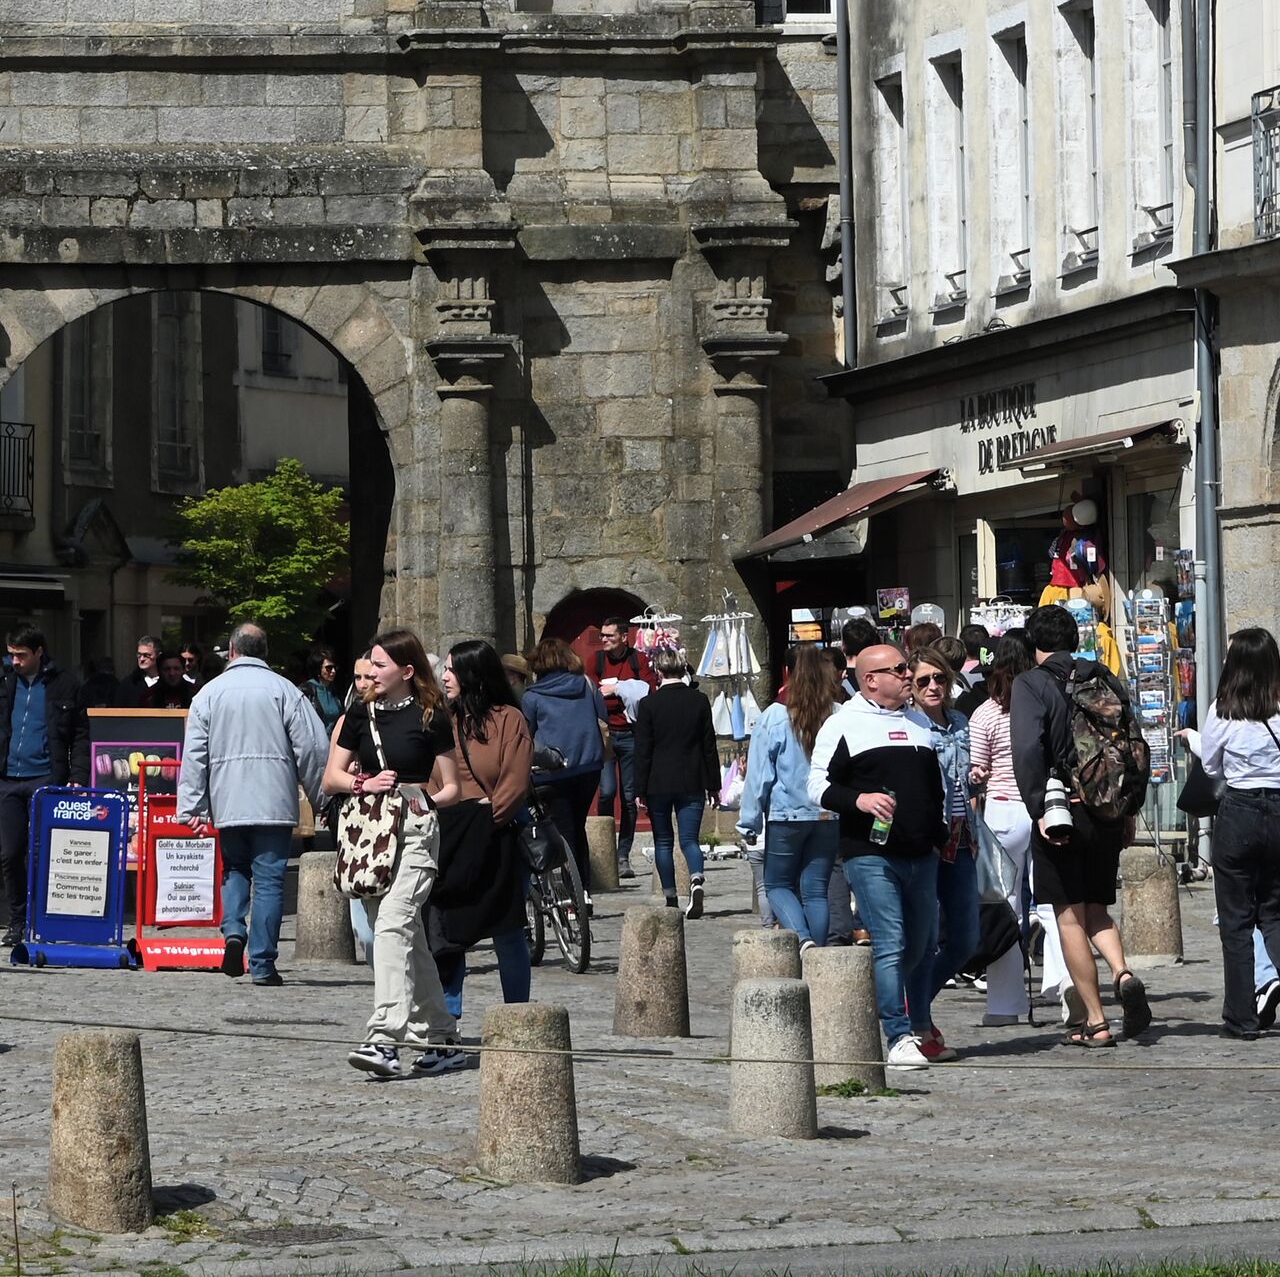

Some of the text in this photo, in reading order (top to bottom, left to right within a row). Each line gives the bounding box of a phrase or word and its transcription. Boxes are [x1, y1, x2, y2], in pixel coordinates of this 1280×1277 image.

[960, 382, 1037, 434] LA BOUTIQUE
[978, 425, 1057, 475] DE BRETAGNE
[898, 598, 904, 609] 3
[58, 800, 92, 812] ouest
[53, 807, 92, 821] france
[153, 815, 164, 823] Le
[69, 839, 92, 847] Vannes
[158, 840, 213, 849] Golfe du Morbihan
[63, 848, 72, 856] Se
[74, 850, 92, 858] garer
[166, 852, 204, 864] Un kayakiste
[56, 857, 72, 865] c'est
[170, 861, 200, 872] recherché
[54, 874, 102, 883] Piscines privées
[55, 883, 99, 892] Comment le
[174, 881, 195, 890] Sulniac
[51, 891, 64, 899] fisc
[79, 893, 102, 901] traque
[167, 893, 177, 901] Oui
[188, 894, 201, 905] parc
[161, 905, 206, 918] photovoltaïque
[146, 946, 225, 958] Le Télégram
